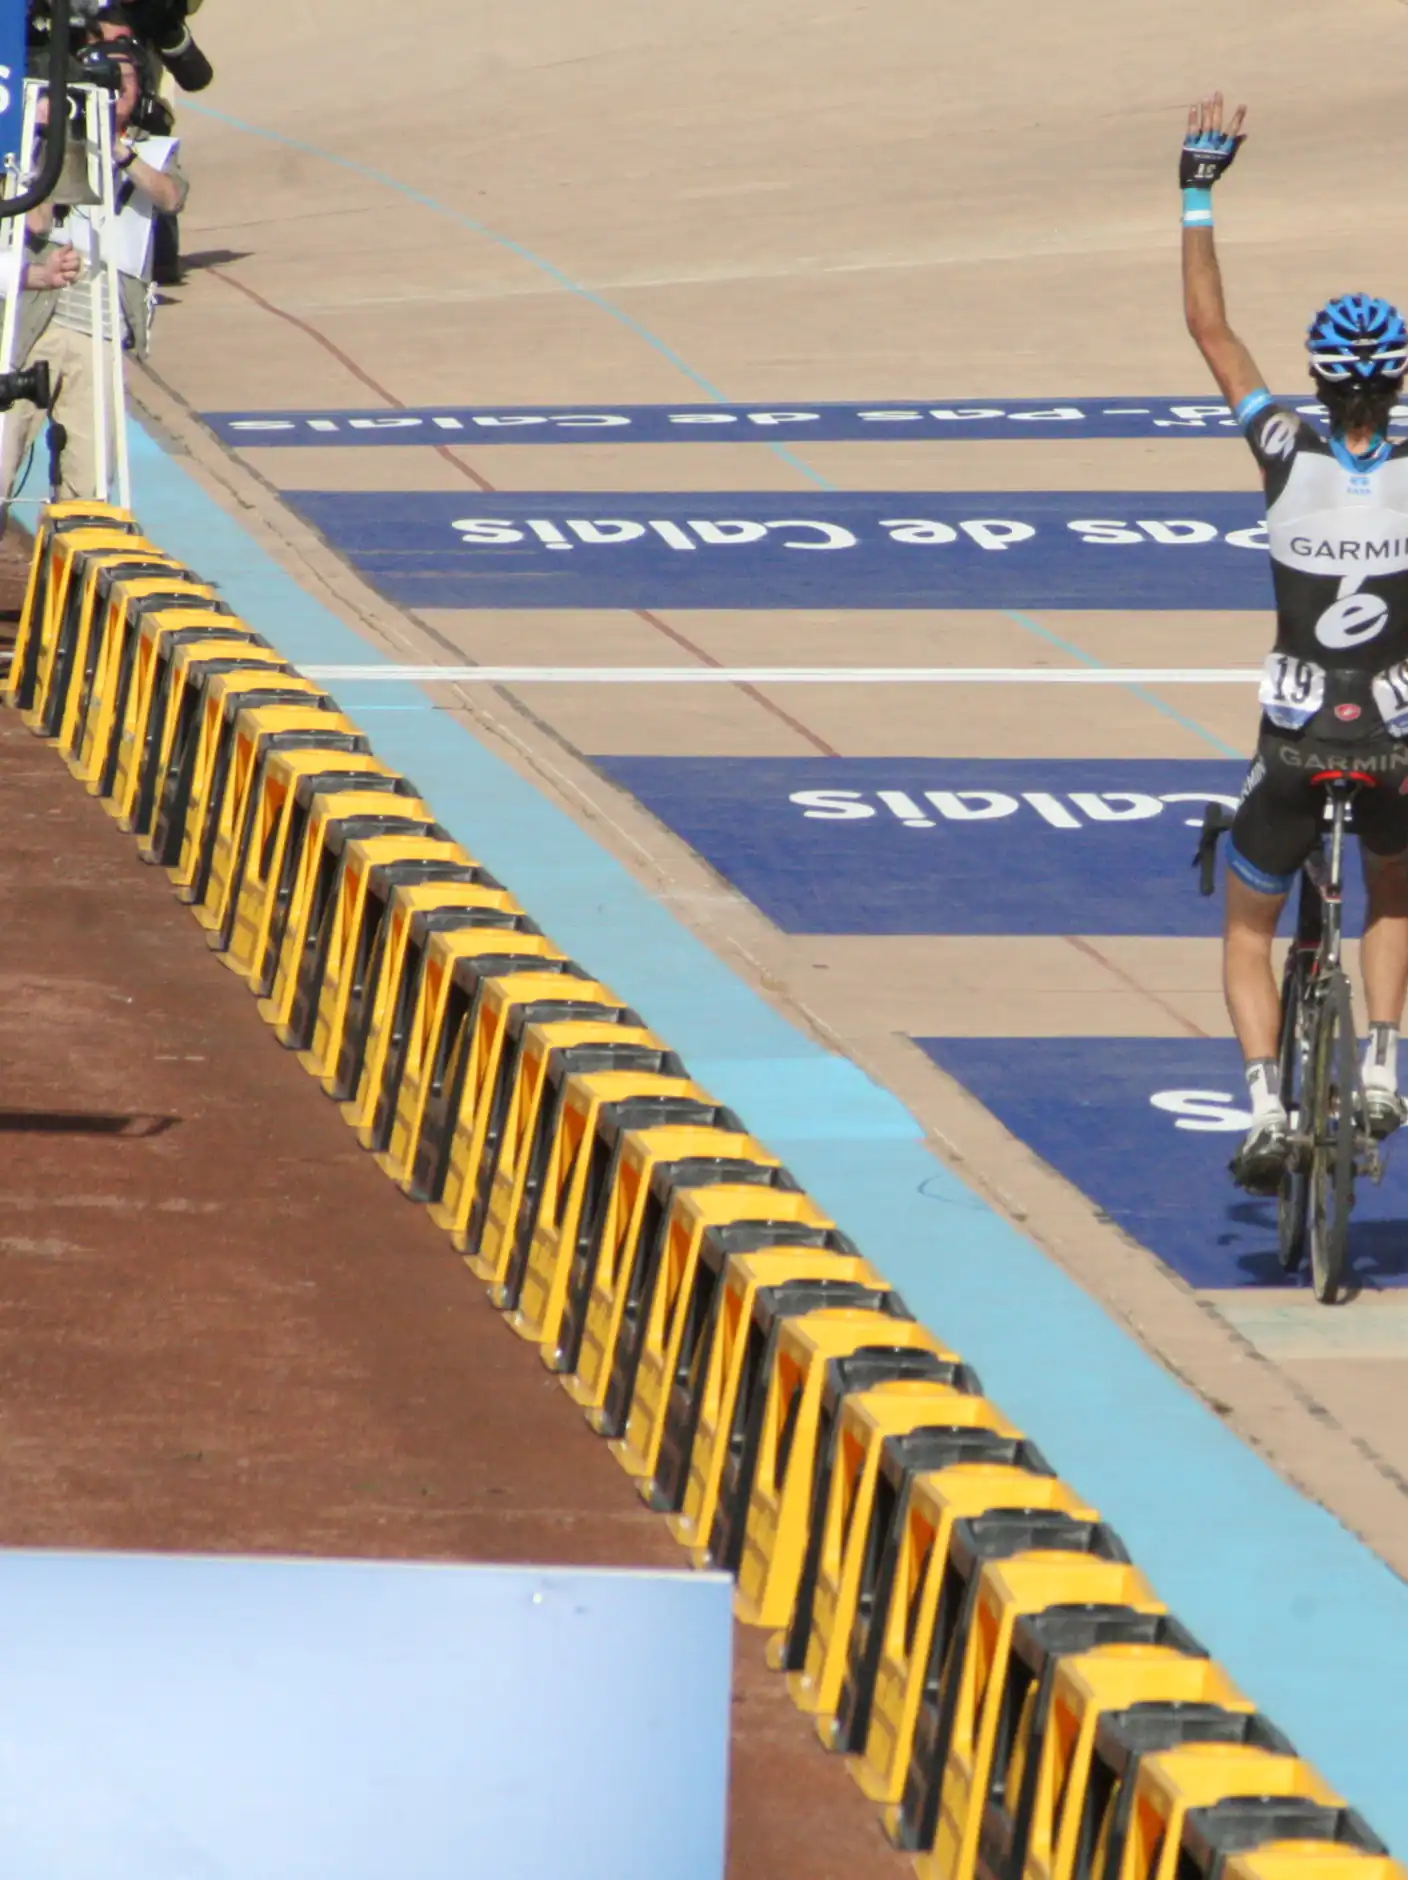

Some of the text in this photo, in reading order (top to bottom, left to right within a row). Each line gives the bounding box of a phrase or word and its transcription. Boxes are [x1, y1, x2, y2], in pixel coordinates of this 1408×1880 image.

[227, 415, 633, 432] Calais
[666, 412, 821, 426] de
[451, 517, 860, 551] Calais
[879, 518, 1037, 551] de
[1273, 655, 1313, 703] 19
[788, 789, 1242, 830] Calais
